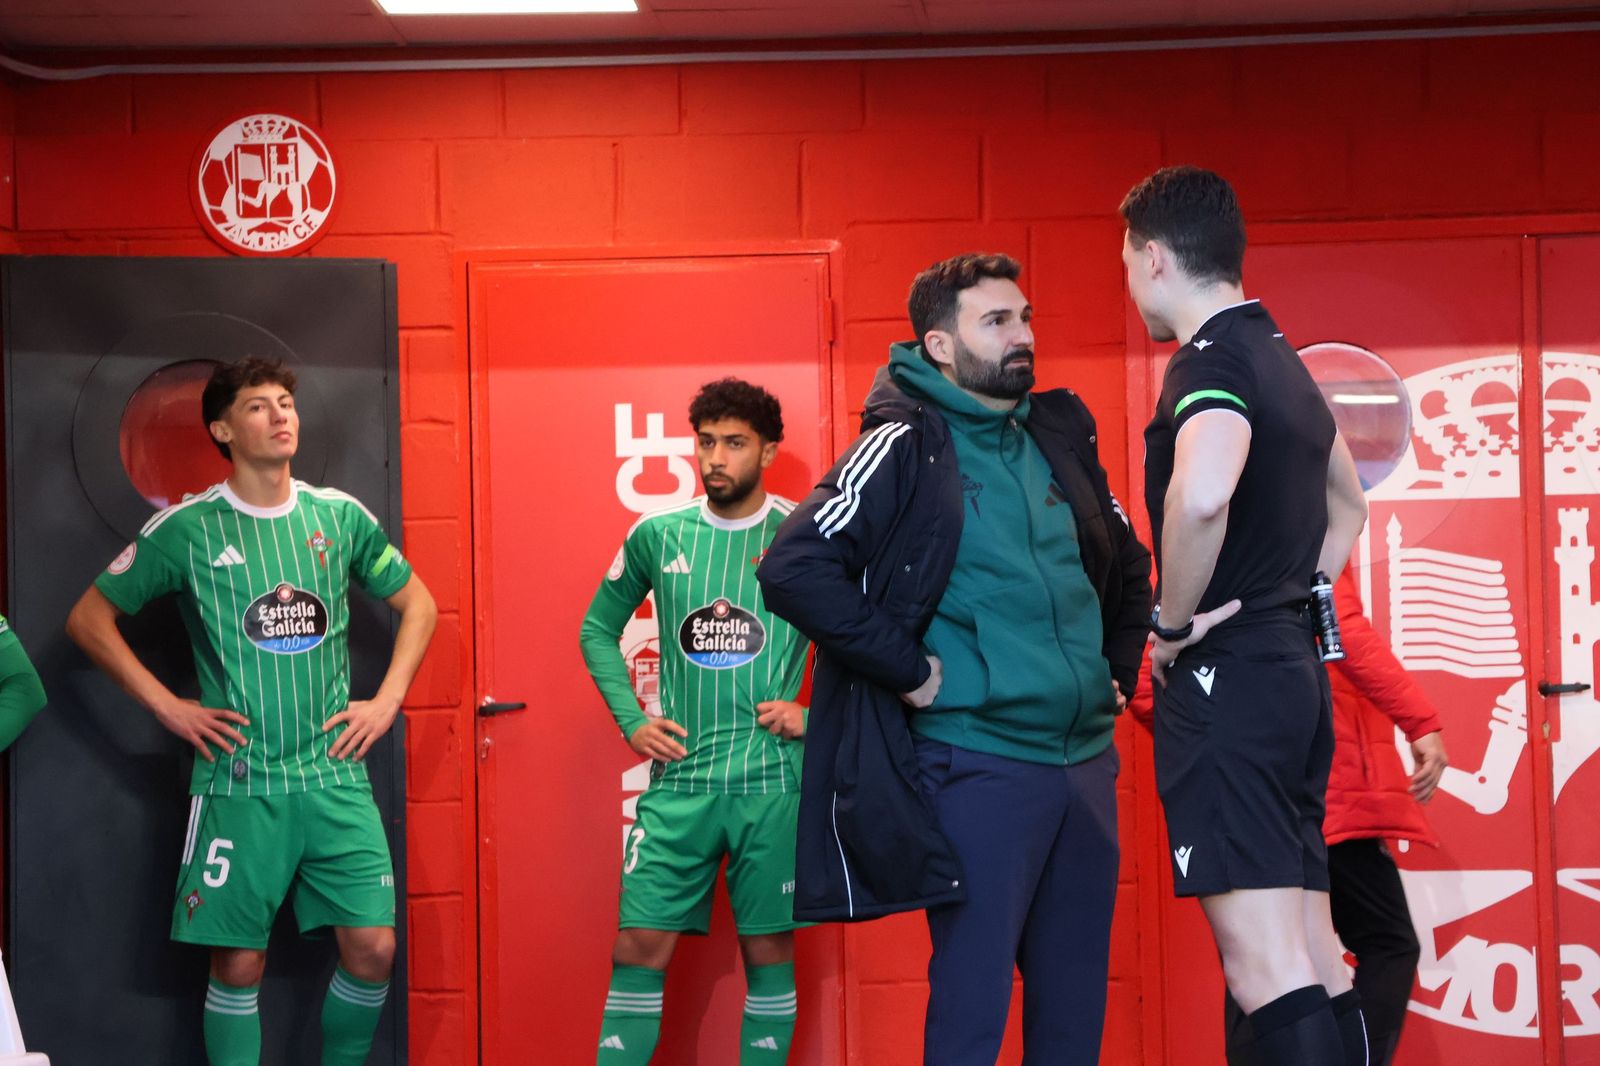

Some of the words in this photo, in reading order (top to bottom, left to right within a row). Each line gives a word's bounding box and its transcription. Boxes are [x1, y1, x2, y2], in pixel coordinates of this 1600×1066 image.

[217, 221, 289, 250] ZAMORA
[614, 403, 697, 514] CF
[258, 601, 316, 621] Estrella
[261, 617, 315, 637] Galicia
[691, 617, 750, 635] Estrella
[692, 633, 746, 651] Galicia
[203, 838, 234, 888] 5
[381, 874, 394, 887] FE
[782, 879, 795, 894] FE
